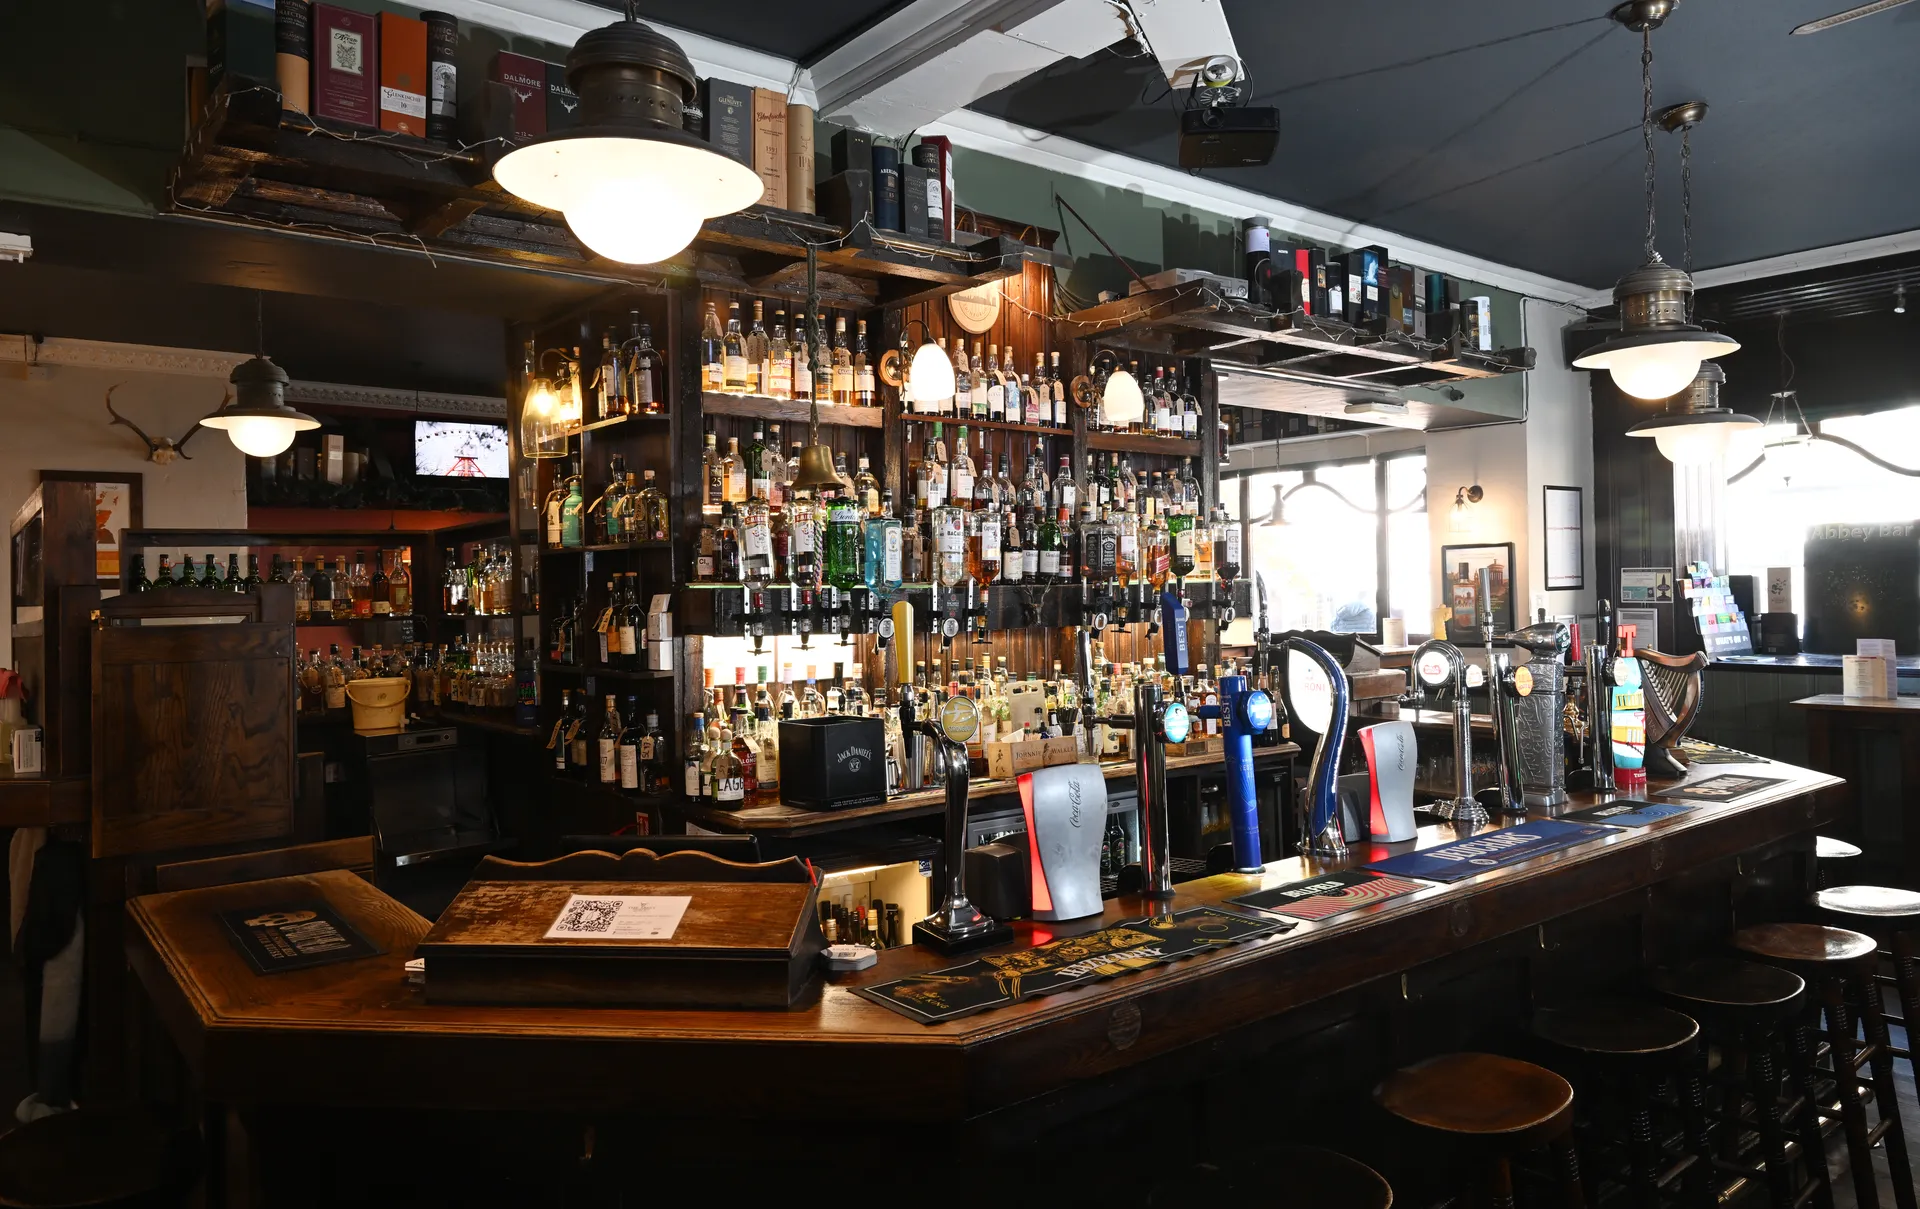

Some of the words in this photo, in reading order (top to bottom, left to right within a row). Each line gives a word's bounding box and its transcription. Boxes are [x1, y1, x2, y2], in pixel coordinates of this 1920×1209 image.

[504, 74, 541, 88] DALMORE
[550, 84, 576, 96] DALM
[712, 477, 722, 487] 25
[1812, 523, 1875, 543] Abbey
[1880, 523, 1915, 538] Bar
[1177, 624, 1186, 651] BEST
[1715, 636, 1733, 646] WHAT'S
[1222, 702, 1232, 727] BEST
[837, 748, 852, 764] JACK
[850, 745, 873, 761] DANIEL'S
[1015, 750, 1041, 760] JOHNNIE
[1050, 746, 1075, 755] WALKER
[1069, 776, 1084, 829] Coca-Cola
[1424, 832, 1542, 861] DEUCHARS
[1054, 954, 1112, 978] HAZY
